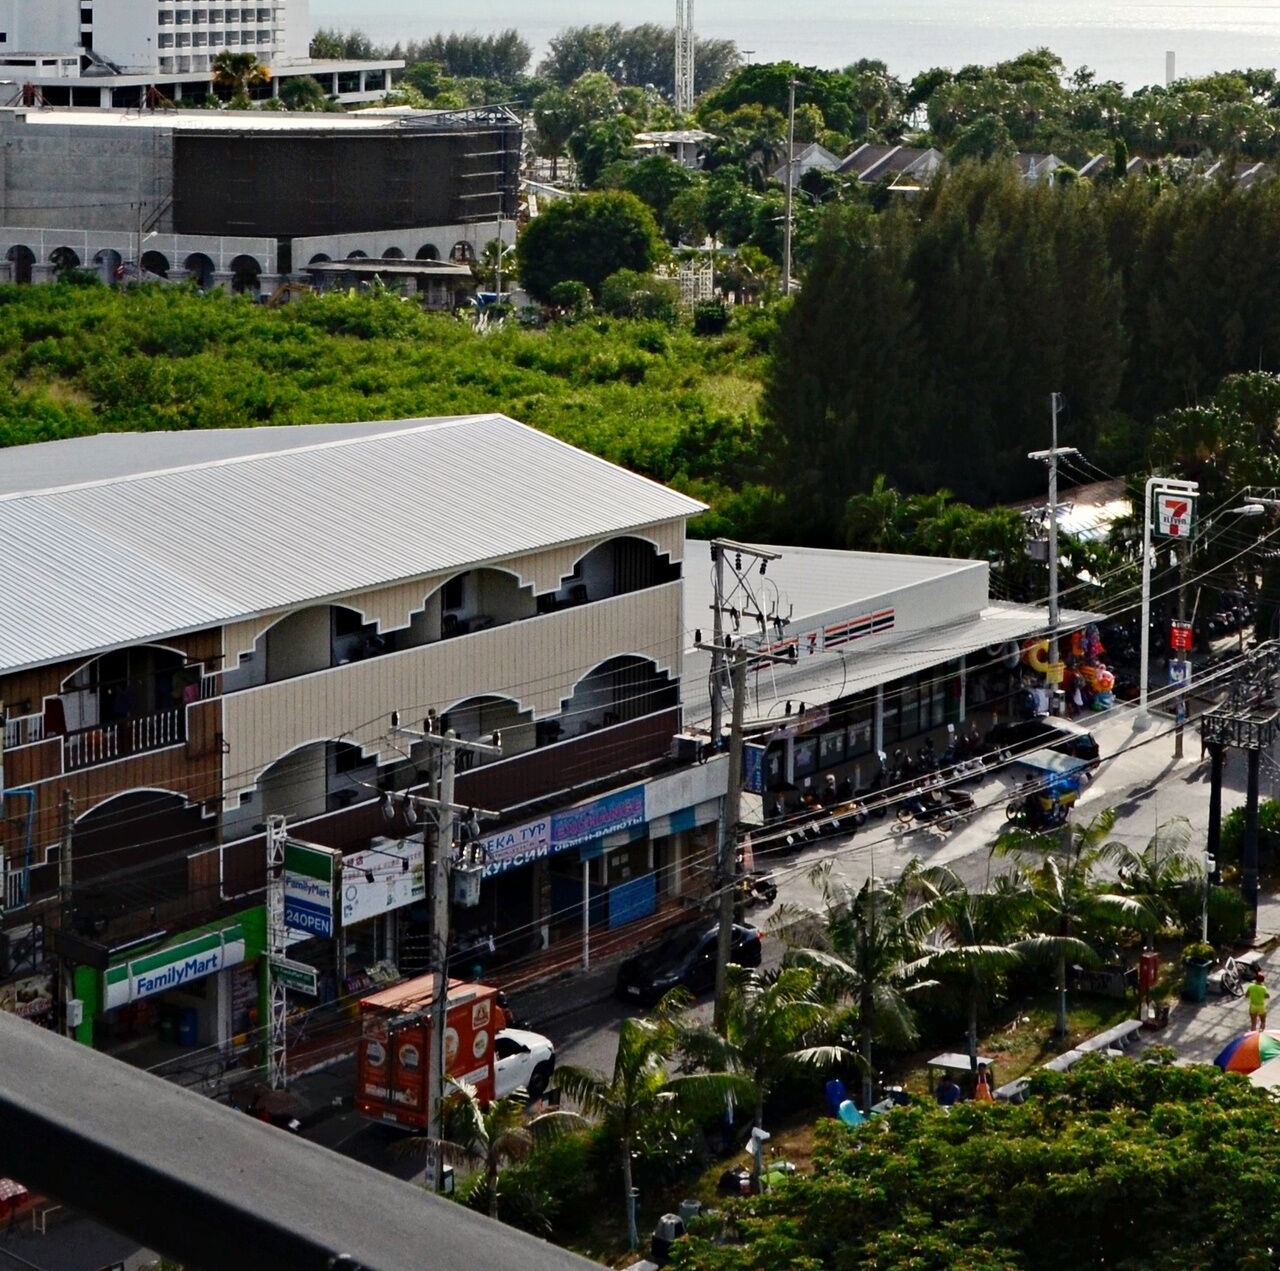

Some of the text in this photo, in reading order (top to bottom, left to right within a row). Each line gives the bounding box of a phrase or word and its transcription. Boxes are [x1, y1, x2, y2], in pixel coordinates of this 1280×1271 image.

[1165, 500, 1188, 536] 7
[483, 834, 515, 851] ЕКА
[519, 823, 546, 840] ТУР
[285, 877, 330, 899] FamilyMart
[137, 953, 218, 995] FamilyMart
